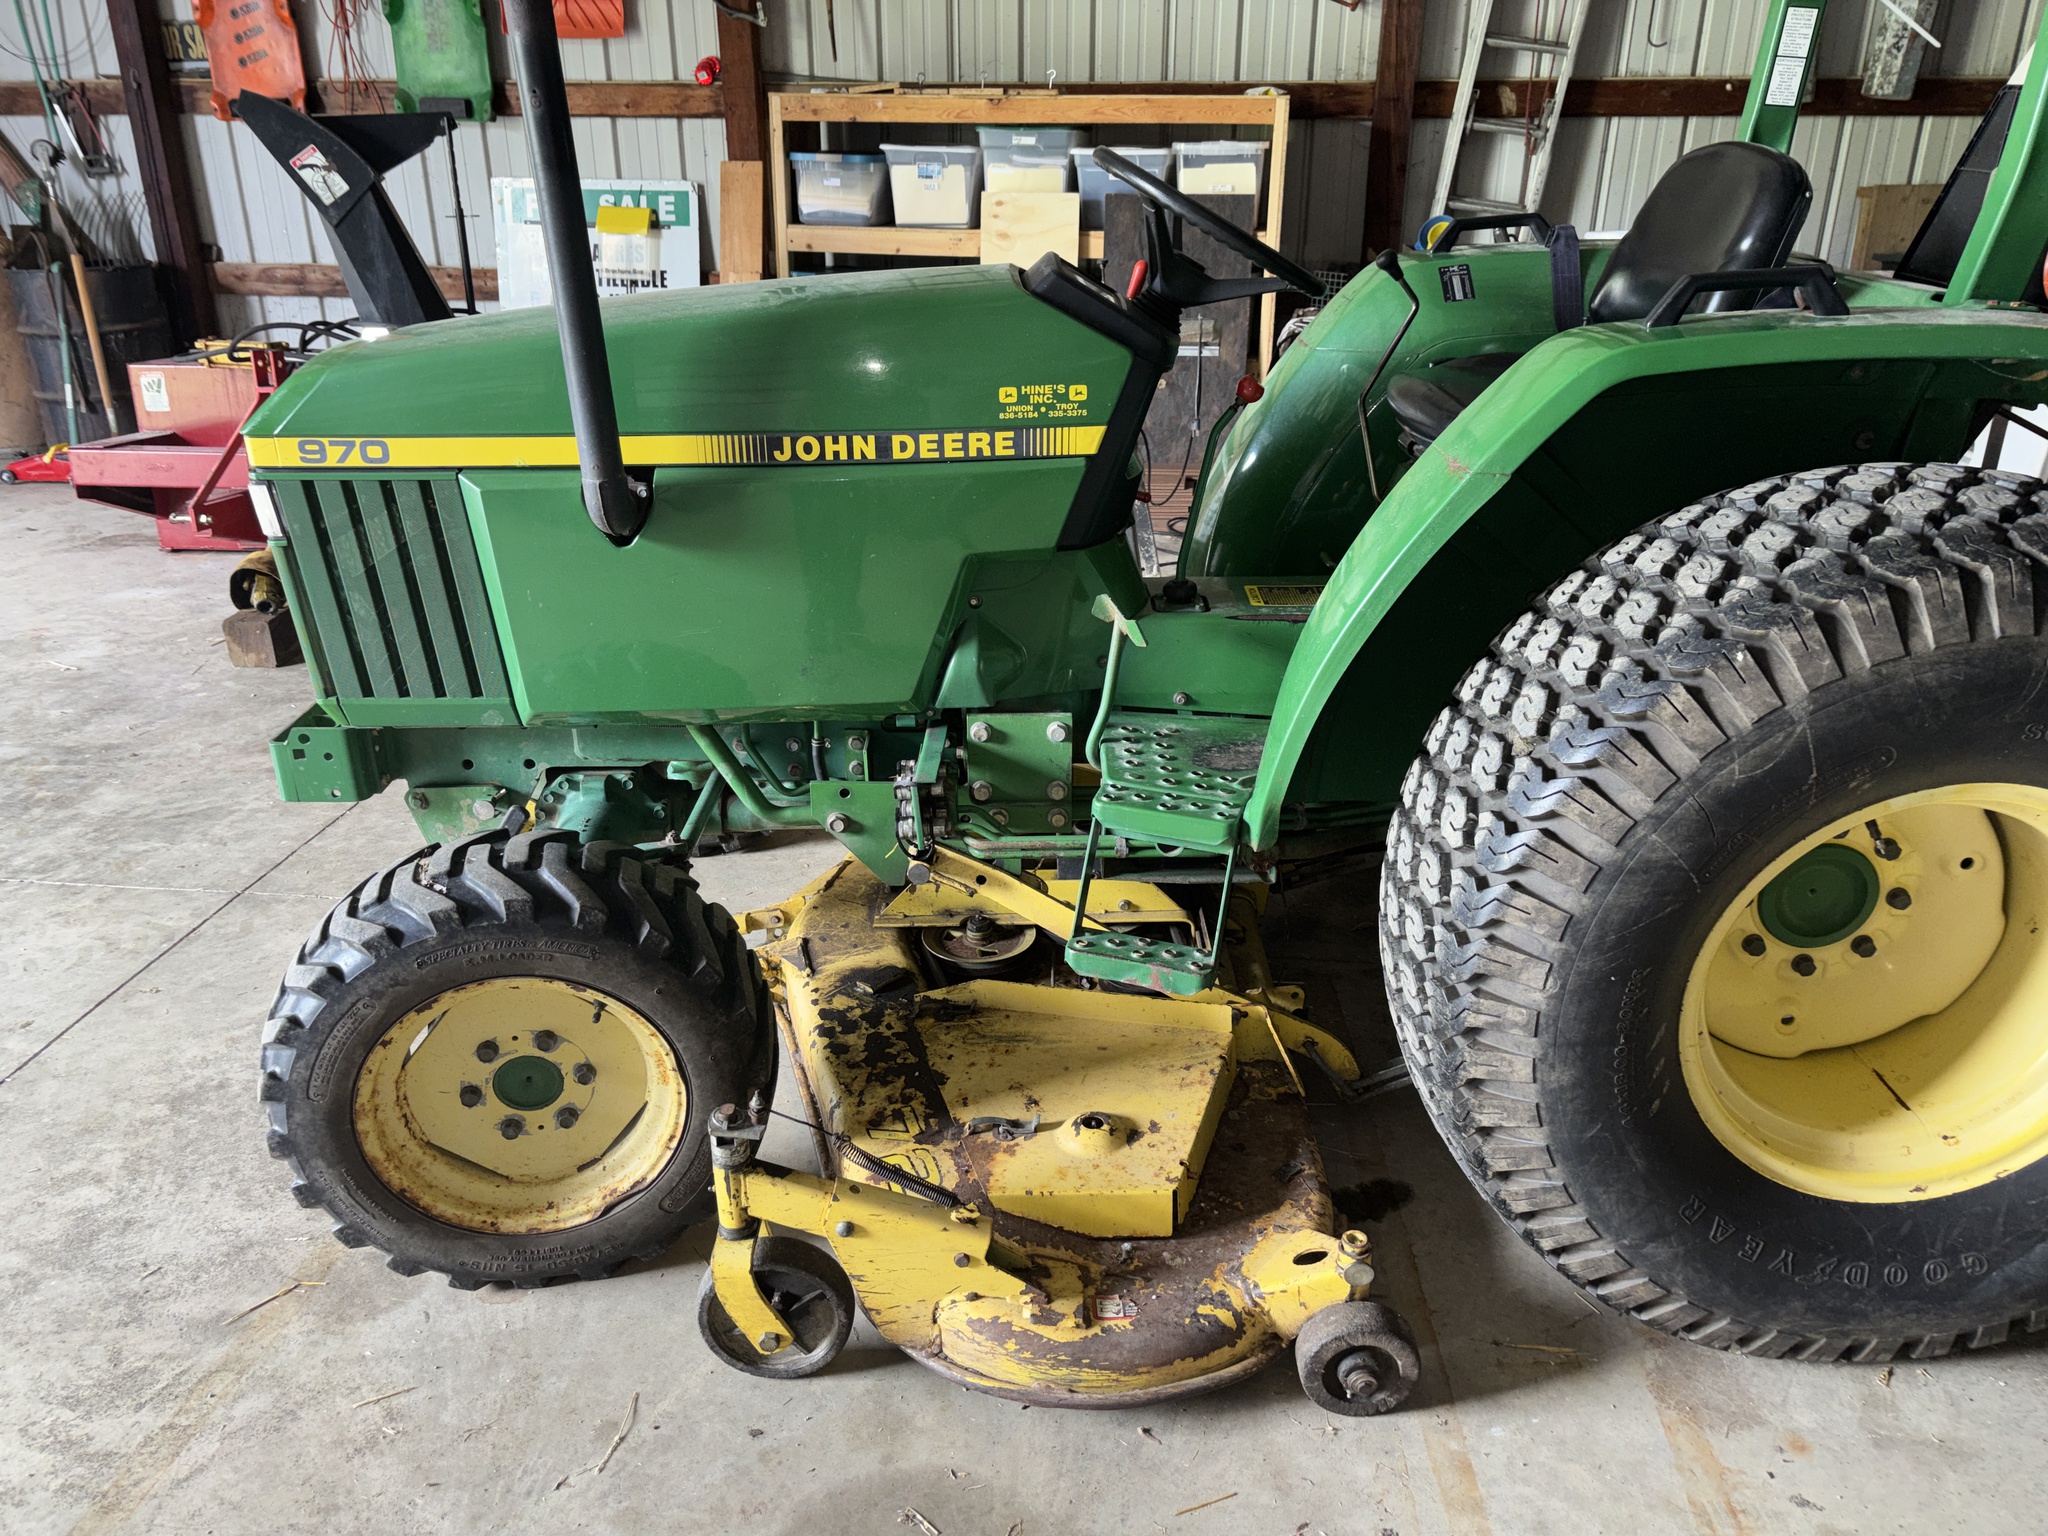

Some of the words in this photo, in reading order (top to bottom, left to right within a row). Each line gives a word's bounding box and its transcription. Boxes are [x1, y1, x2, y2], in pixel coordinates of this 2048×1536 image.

[161, 25, 185, 60] OR
[183, 24, 208, 60] SA
[1021, 384, 1066, 395] HINE'S
[1030, 394, 1057, 404] INC.
[1055, 403, 1079, 411] TROY
[999, 411, 1038, 419] 836-5184
[1048, 409, 1088, 417] 335-3375
[298, 440, 390, 464] 970
[773, 434, 877, 462] JOHN
[891, 431, 1016, 459] DEERE
[1679, 1194, 1989, 1287] GOODYEAR
